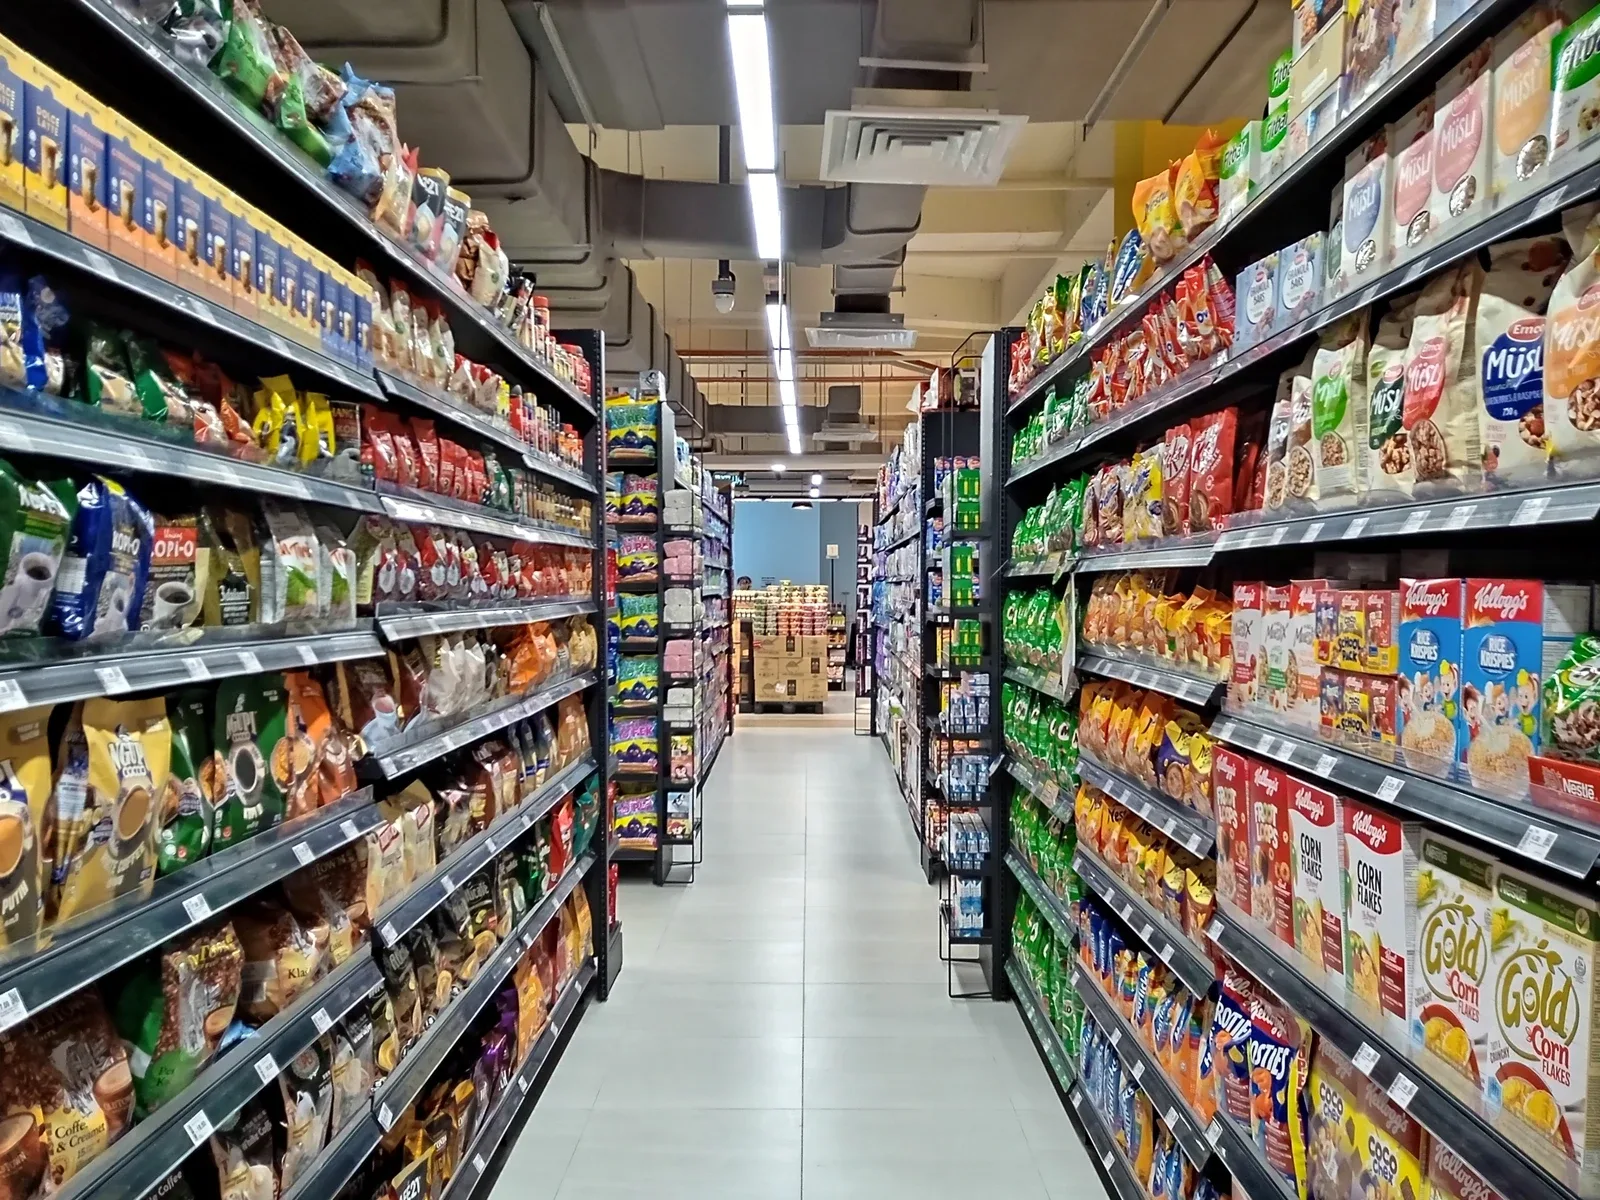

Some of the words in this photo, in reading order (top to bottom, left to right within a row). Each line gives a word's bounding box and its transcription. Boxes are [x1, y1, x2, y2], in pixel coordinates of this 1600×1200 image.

[1272, 58, 1293, 92] Fitba
[1486, 346, 1544, 381] MÜSL
[150, 540, 195, 558] OPI-O
[1405, 583, 1449, 615] Kellogg's
[1474, 582, 1529, 620] Kellogg's
[1338, 636, 1362, 651] SCHOOL
[1416, 630, 1431, 645] RICE
[1488, 637, 1506, 653] RICE
[1410, 645, 1439, 663] KRISPIES
[1480, 650, 1516, 670] KRISPIES
[1254, 765, 1280, 797] Kellogg's
[1562, 777, 1595, 800] Nestlé
[1295, 787, 1325, 822] Kellogg's
[1352, 810, 1388, 848] Kellogg's
[1300, 832, 1322, 864] CORN
[1301, 854, 1323, 882] FLAKES
[1356, 859, 1382, 895] CORN
[1357, 885, 1383, 915] FLAKES
[1425, 916, 1483, 981] Gold
[1450, 970, 1480, 1007] Corn
[1502, 963, 1573, 1039] Gold
[1458, 999, 1480, 1023] FLAKES
[1250, 1038, 1291, 1081] OSTIES
[1531, 1024, 1569, 1069] Corn
[1542, 1061, 1571, 1087] FLAKES
[1319, 1082, 1344, 1115] COCO
[1366, 1083, 1409, 1134] Kellogg's
[56, 1141, 67, 1154] &
[1368, 1135, 1398, 1175] COCO
[157, 1169, 184, 1198] Coffee
